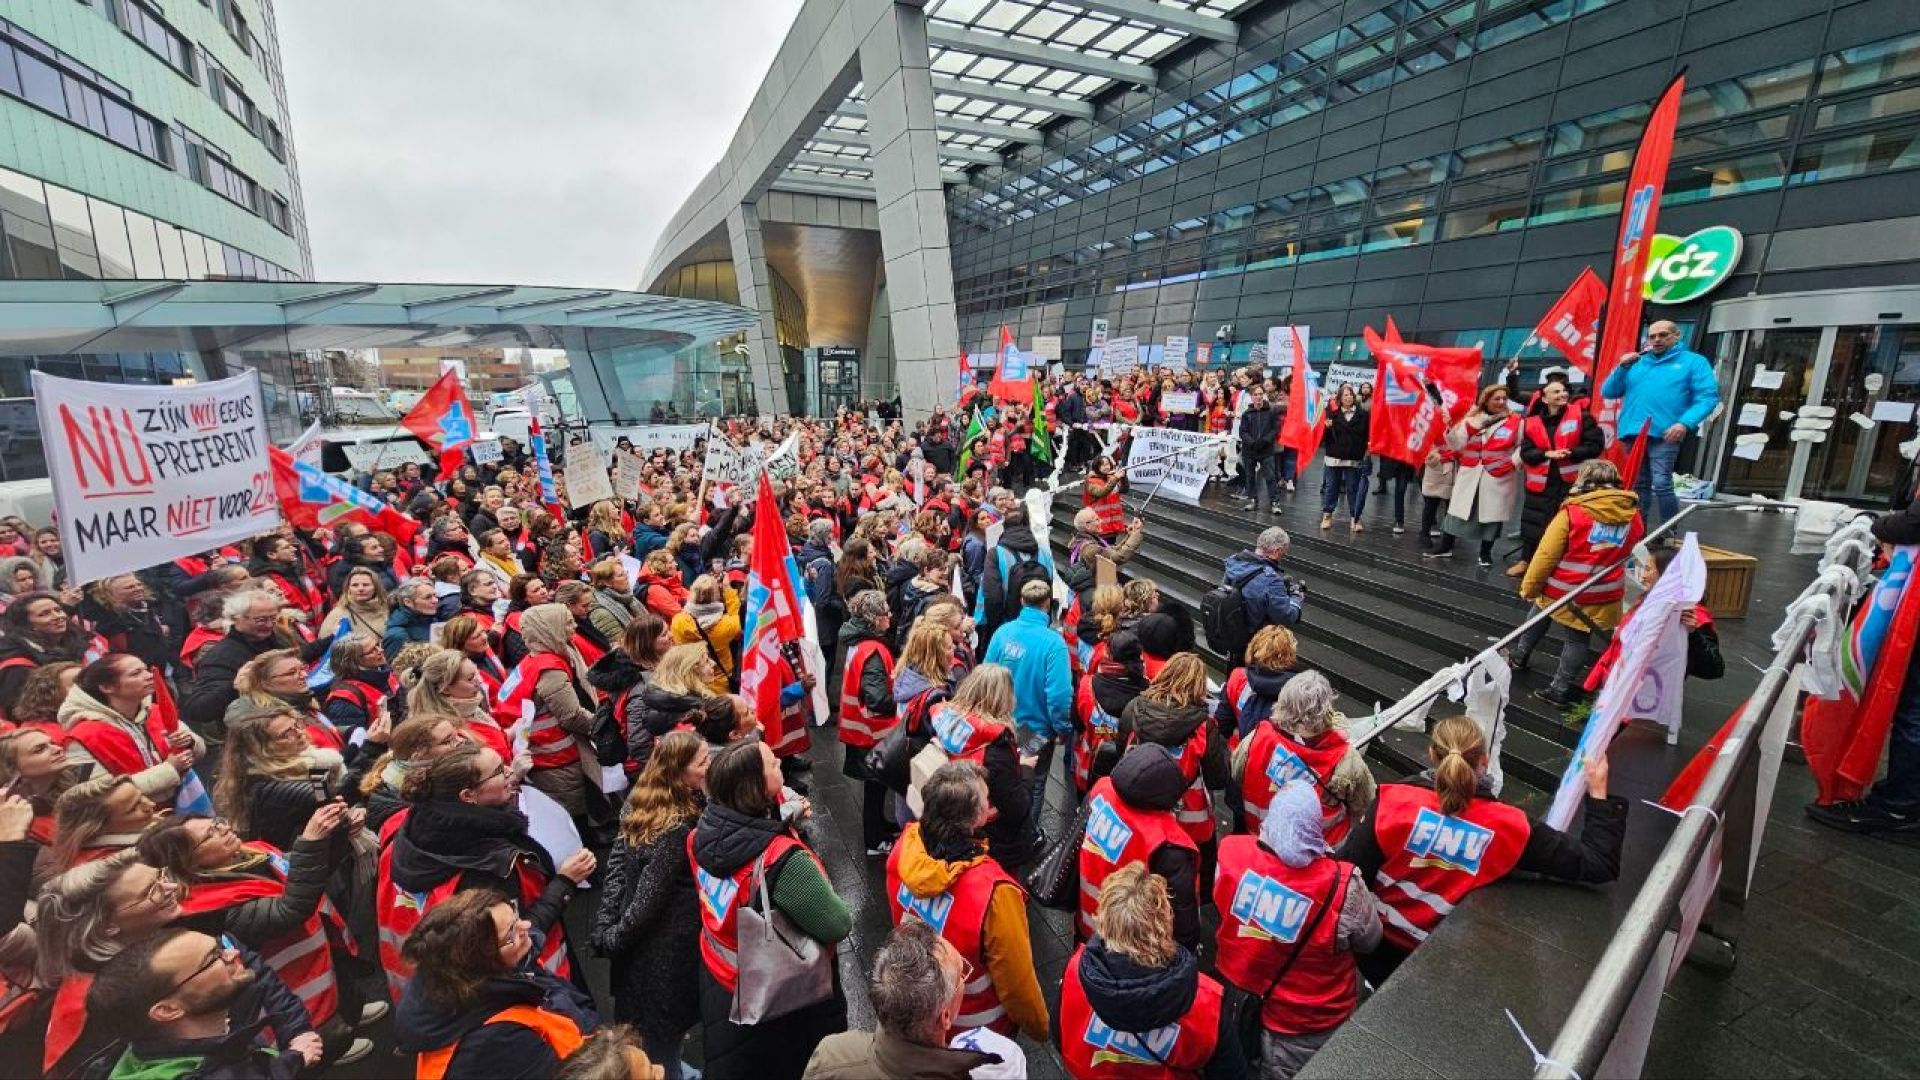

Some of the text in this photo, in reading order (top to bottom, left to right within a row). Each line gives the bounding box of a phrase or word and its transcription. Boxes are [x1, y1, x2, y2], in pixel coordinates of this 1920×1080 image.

[219, 395, 254, 424] EENS
[60, 403, 154, 489] NU
[145, 426, 258, 480] PREFERENT
[74, 506, 161, 553] MAAR
[218, 489, 253, 521] VOOR
[1412, 821, 1490, 860] FNV
[1233, 883, 1307, 927] FNV
